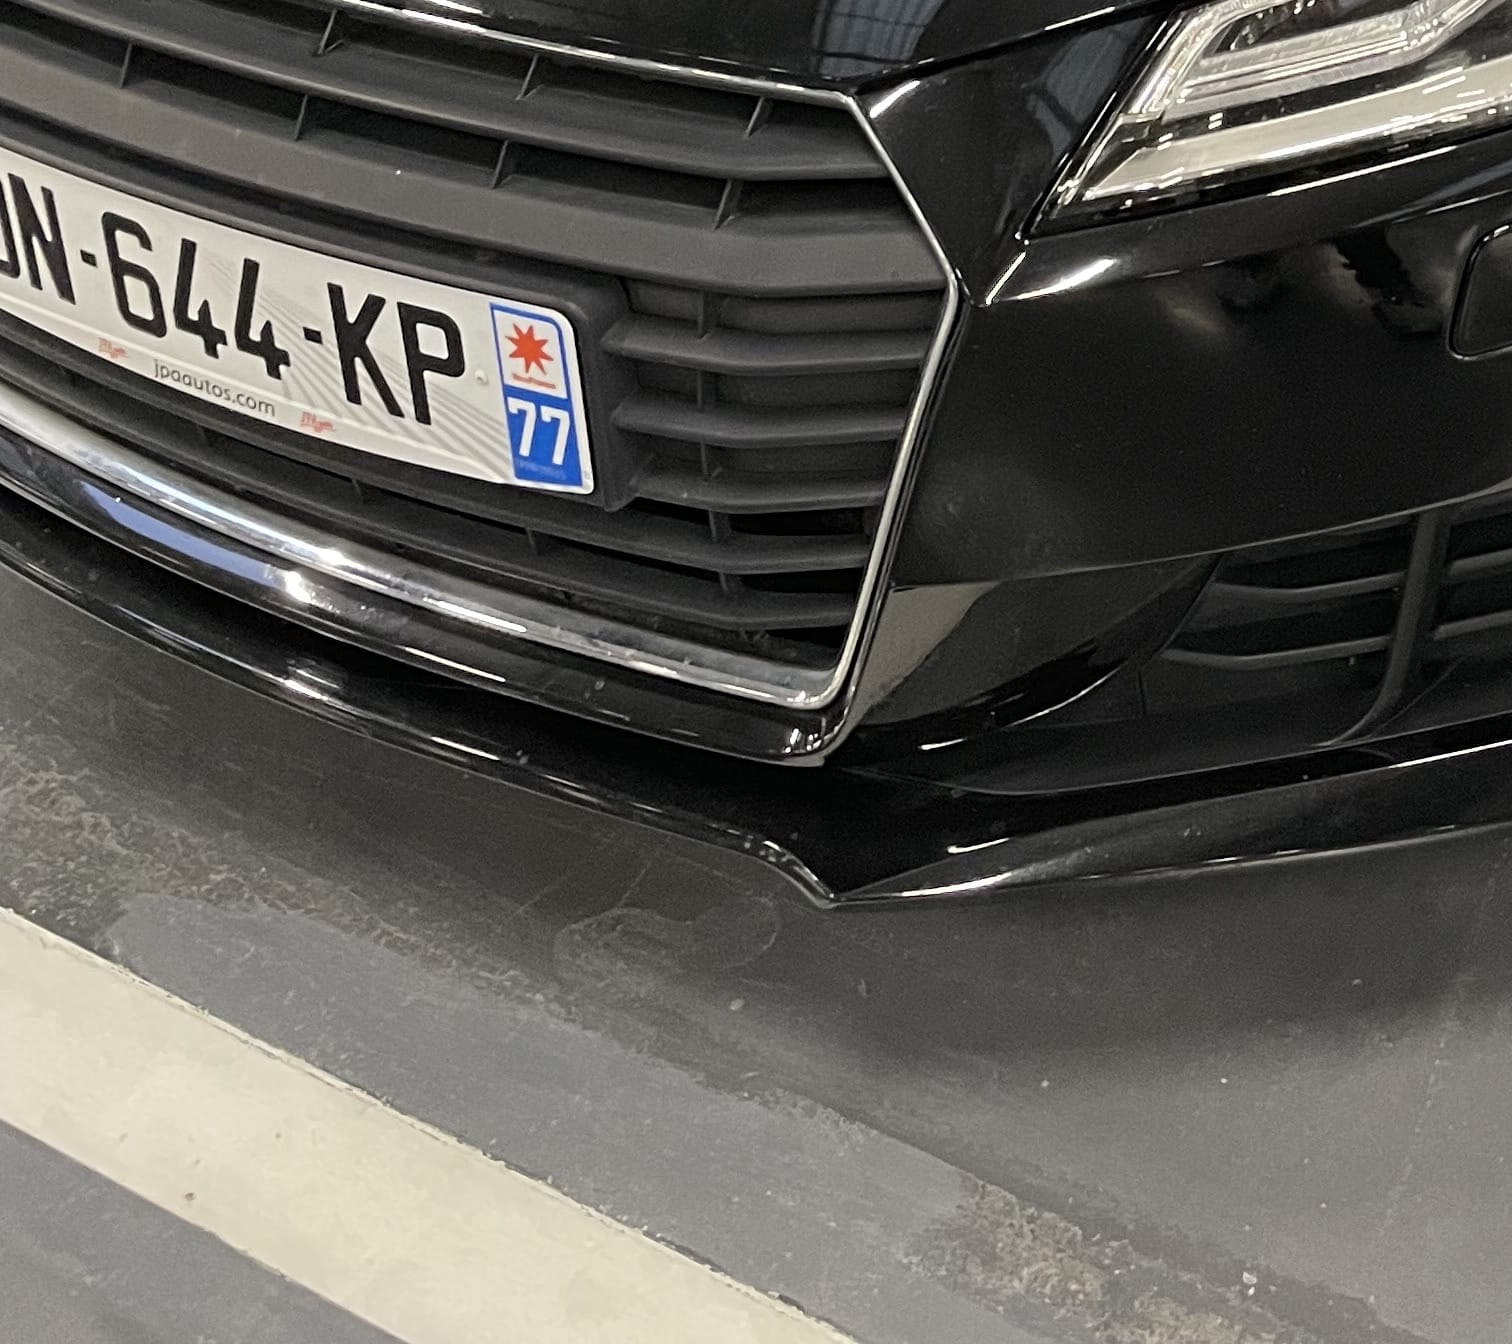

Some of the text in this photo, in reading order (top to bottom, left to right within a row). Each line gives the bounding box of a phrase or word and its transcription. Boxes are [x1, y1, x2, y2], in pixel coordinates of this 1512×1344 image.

[0, 173, 467, 425] N-644-KP
[153, 358, 276, 417] jpaautos.com
[506, 396, 571, 466] 77
